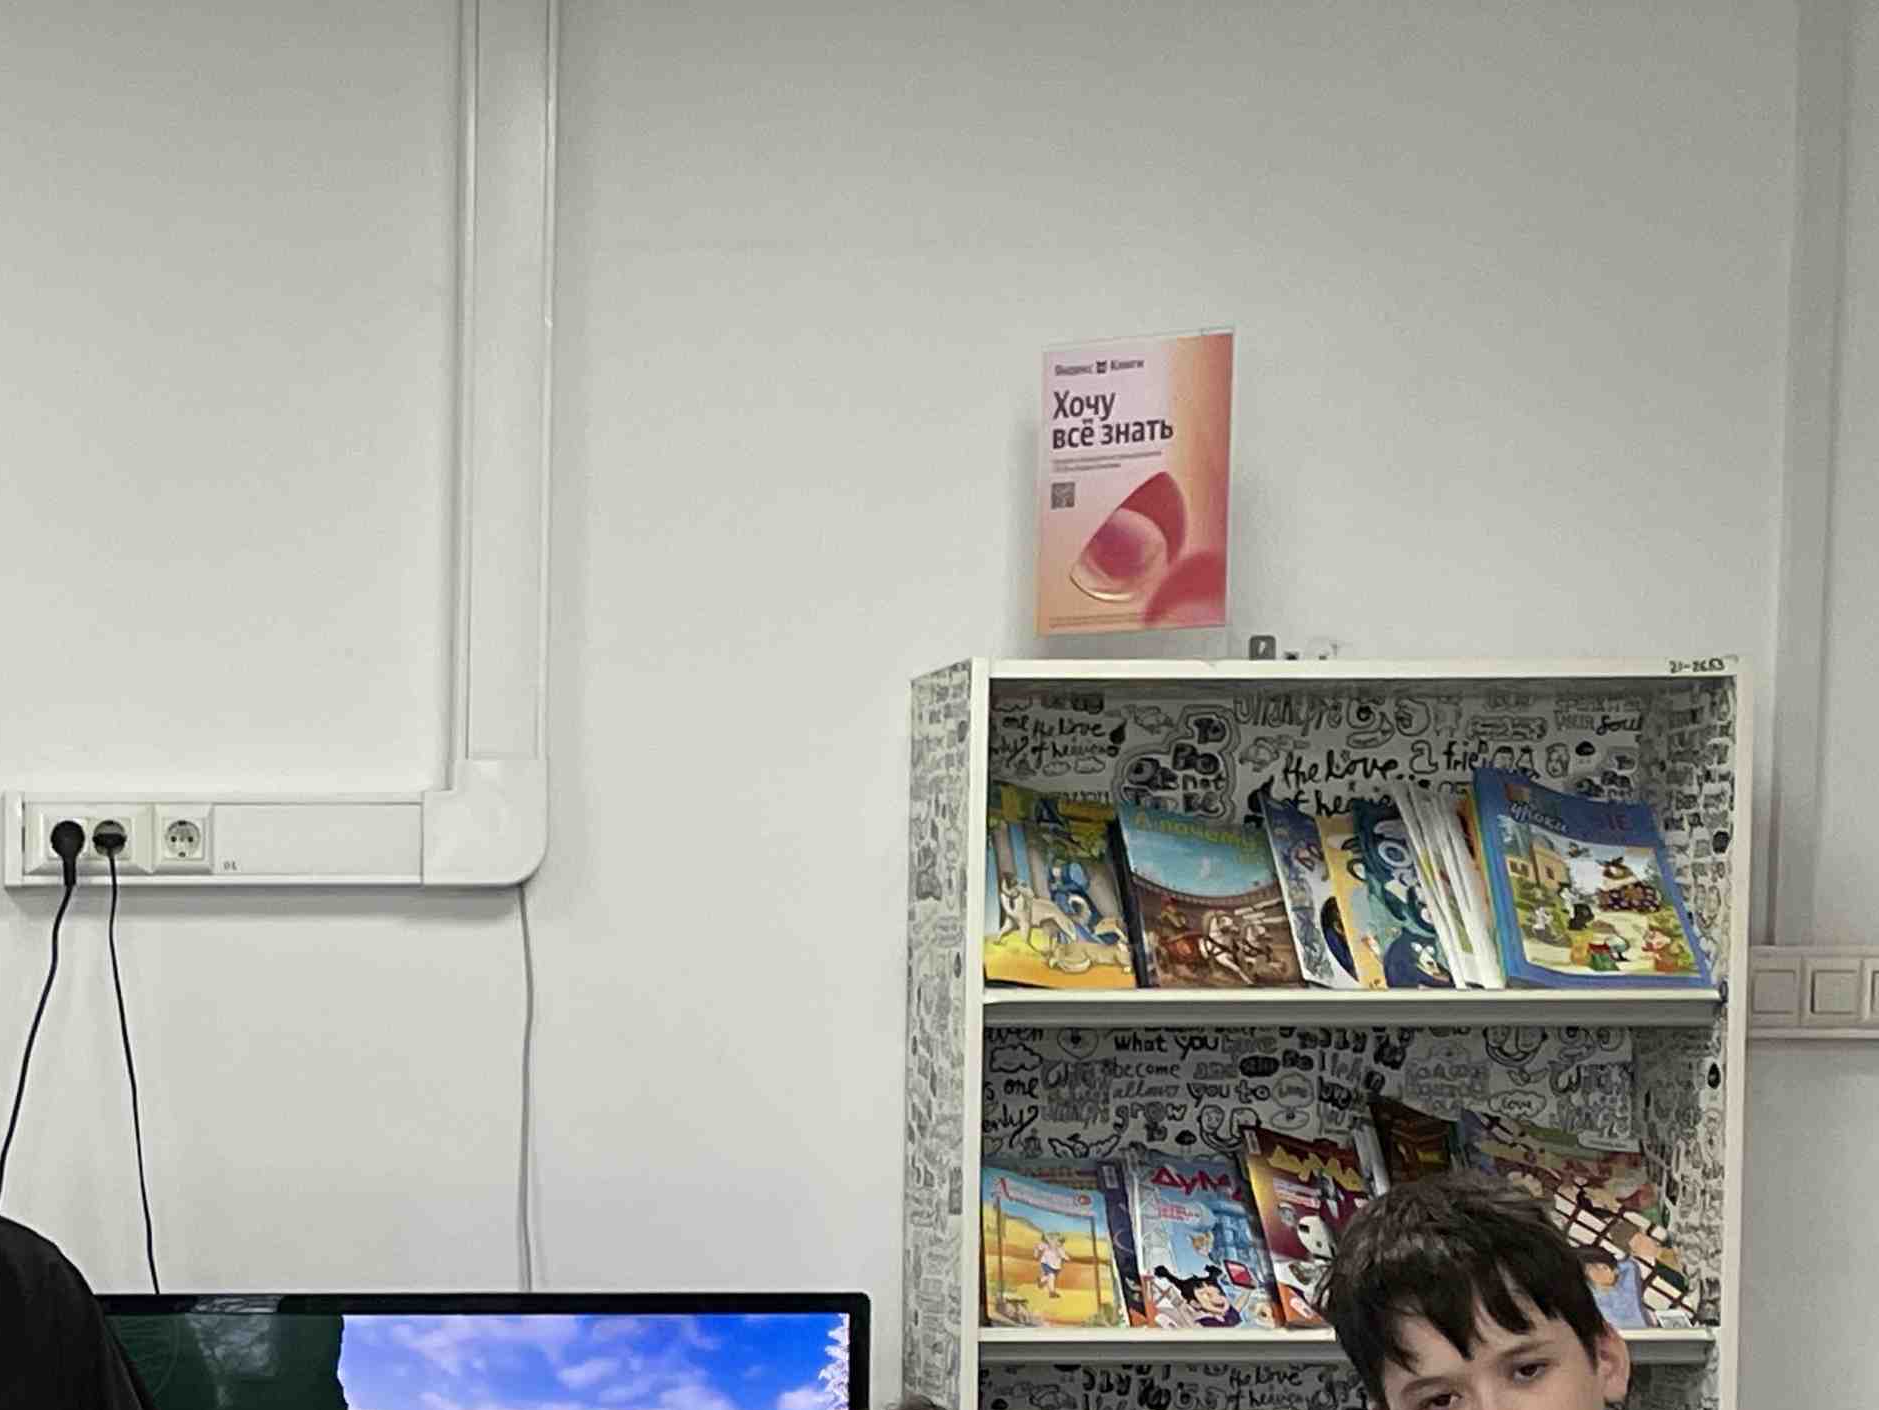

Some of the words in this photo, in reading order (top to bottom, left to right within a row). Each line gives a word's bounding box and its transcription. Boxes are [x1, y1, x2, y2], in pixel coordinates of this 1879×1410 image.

[1052, 389, 1117, 422] Хочу
[1052, 419, 1095, 450] всё
[1100, 418, 1175, 446] знать
[1173, 1035, 1219, 1060] you
[1187, 1082, 1231, 1108] you
